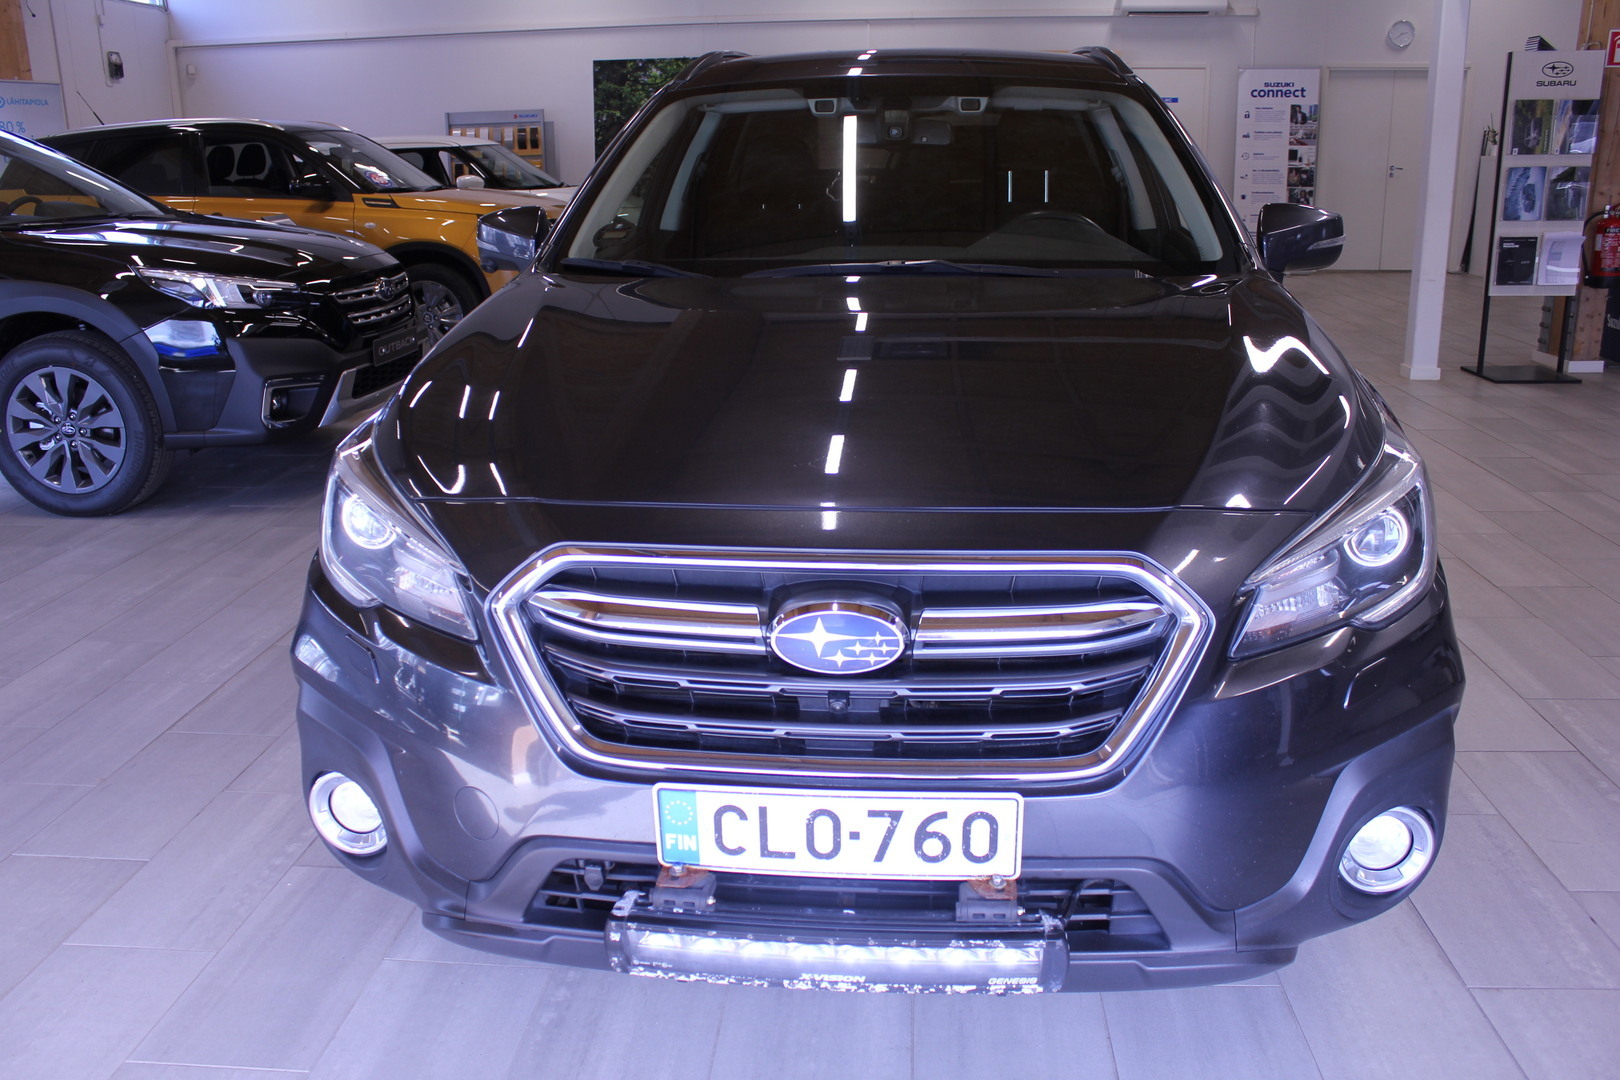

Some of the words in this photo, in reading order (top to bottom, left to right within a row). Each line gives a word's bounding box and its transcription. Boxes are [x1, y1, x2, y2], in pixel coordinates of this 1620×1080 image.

[1251, 87, 1306, 98] connect
[6, 97, 49, 105] LÄHITAPIOLA
[665, 833, 697, 851] FIN
[988, 977, 1038, 985] GENESIS
